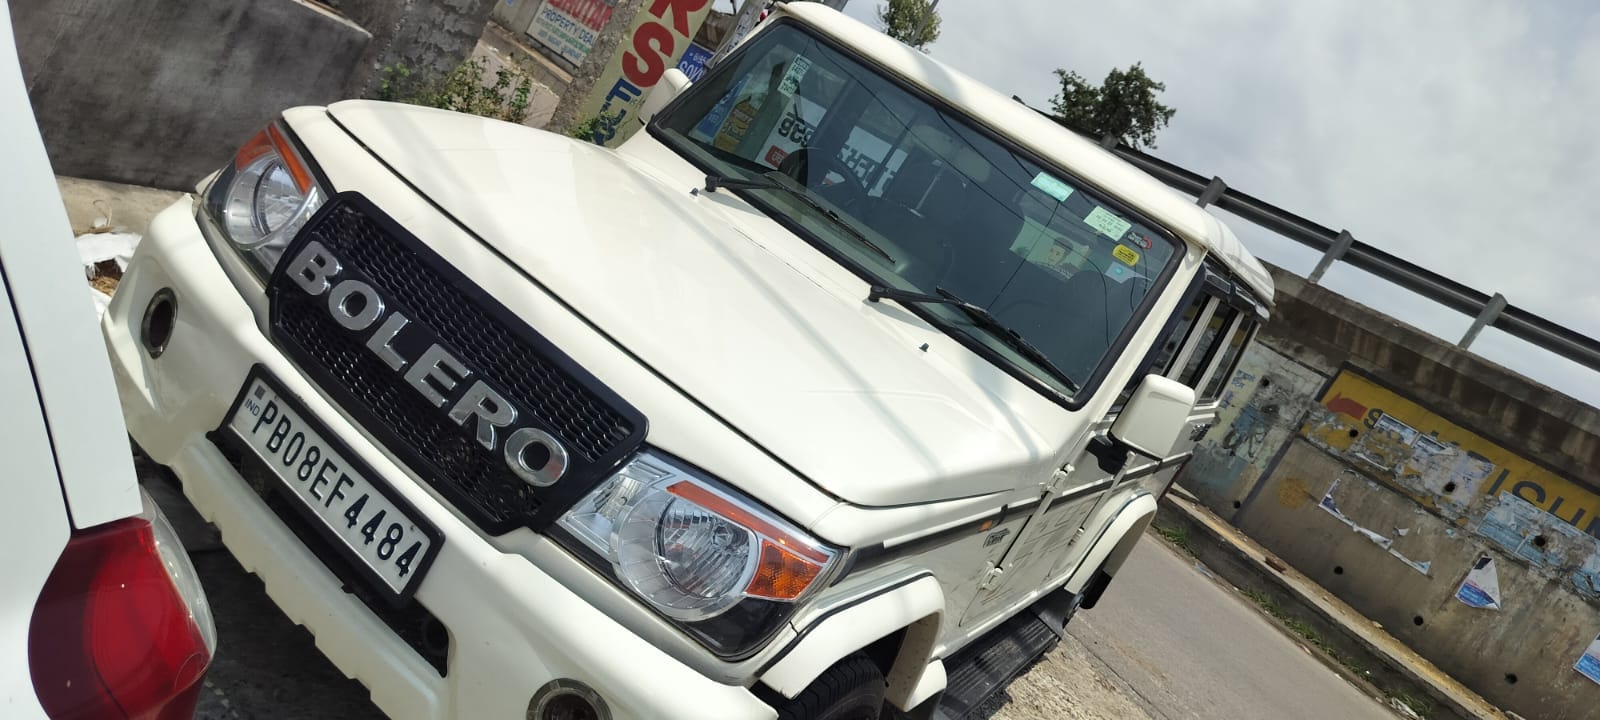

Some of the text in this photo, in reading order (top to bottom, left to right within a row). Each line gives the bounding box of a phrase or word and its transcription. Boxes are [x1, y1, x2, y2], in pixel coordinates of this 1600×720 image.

[541, 7, 580, 35] PROPERTY
[244, 398, 260, 417] IND
[286, 240, 569, 487] BOLERO
[252, 400, 422, 577] PB08EF4484
